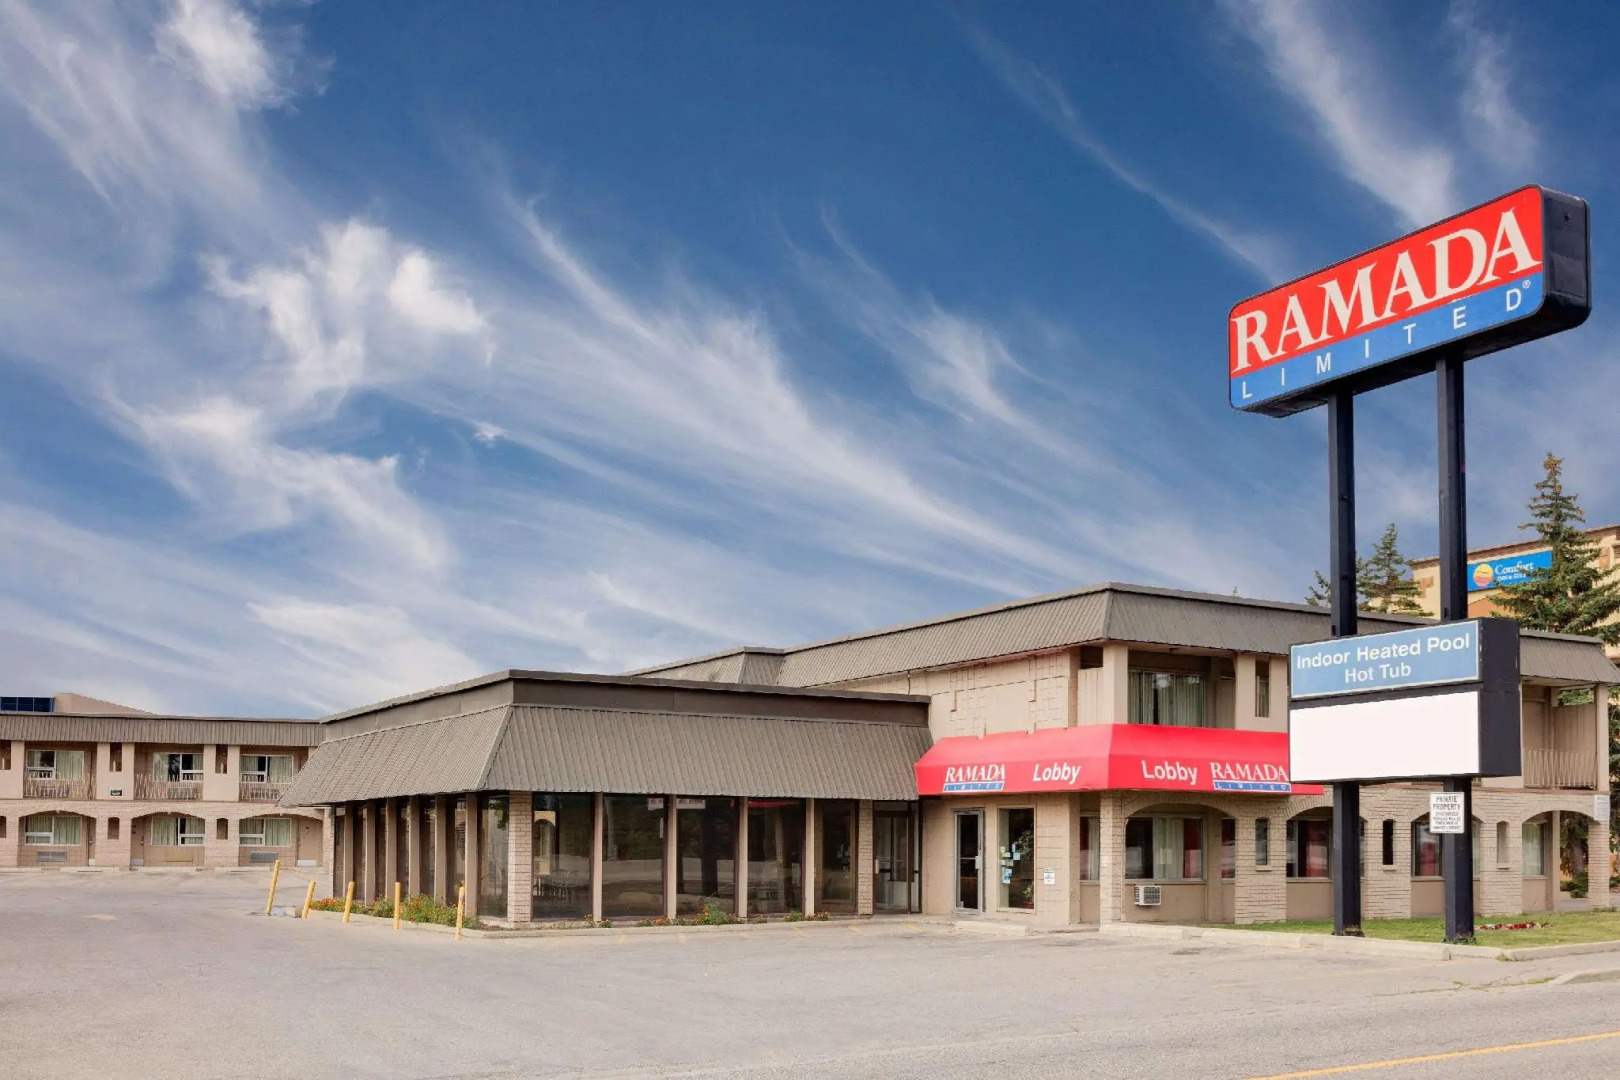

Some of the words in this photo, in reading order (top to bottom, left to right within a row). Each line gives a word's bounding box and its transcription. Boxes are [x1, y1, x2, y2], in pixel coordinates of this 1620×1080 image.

[1230, 207, 1543, 373] RAMADA
[1242, 288, 1522, 399] LIMITED
[1494, 560, 1535, 575] Comfort
[1296, 651, 1350, 669] Indoor
[1356, 639, 1421, 662] Heated
[1427, 633, 1470, 653] Pool
[1345, 668, 1374, 683] Hot
[1379, 662, 1412, 679] Tub
[945, 764, 1006, 782] RAMADA
[1032, 762, 1082, 785] Lobby
[1141, 760, 1197, 786] Lobby
[1210, 762, 1289, 782] RAMADA
